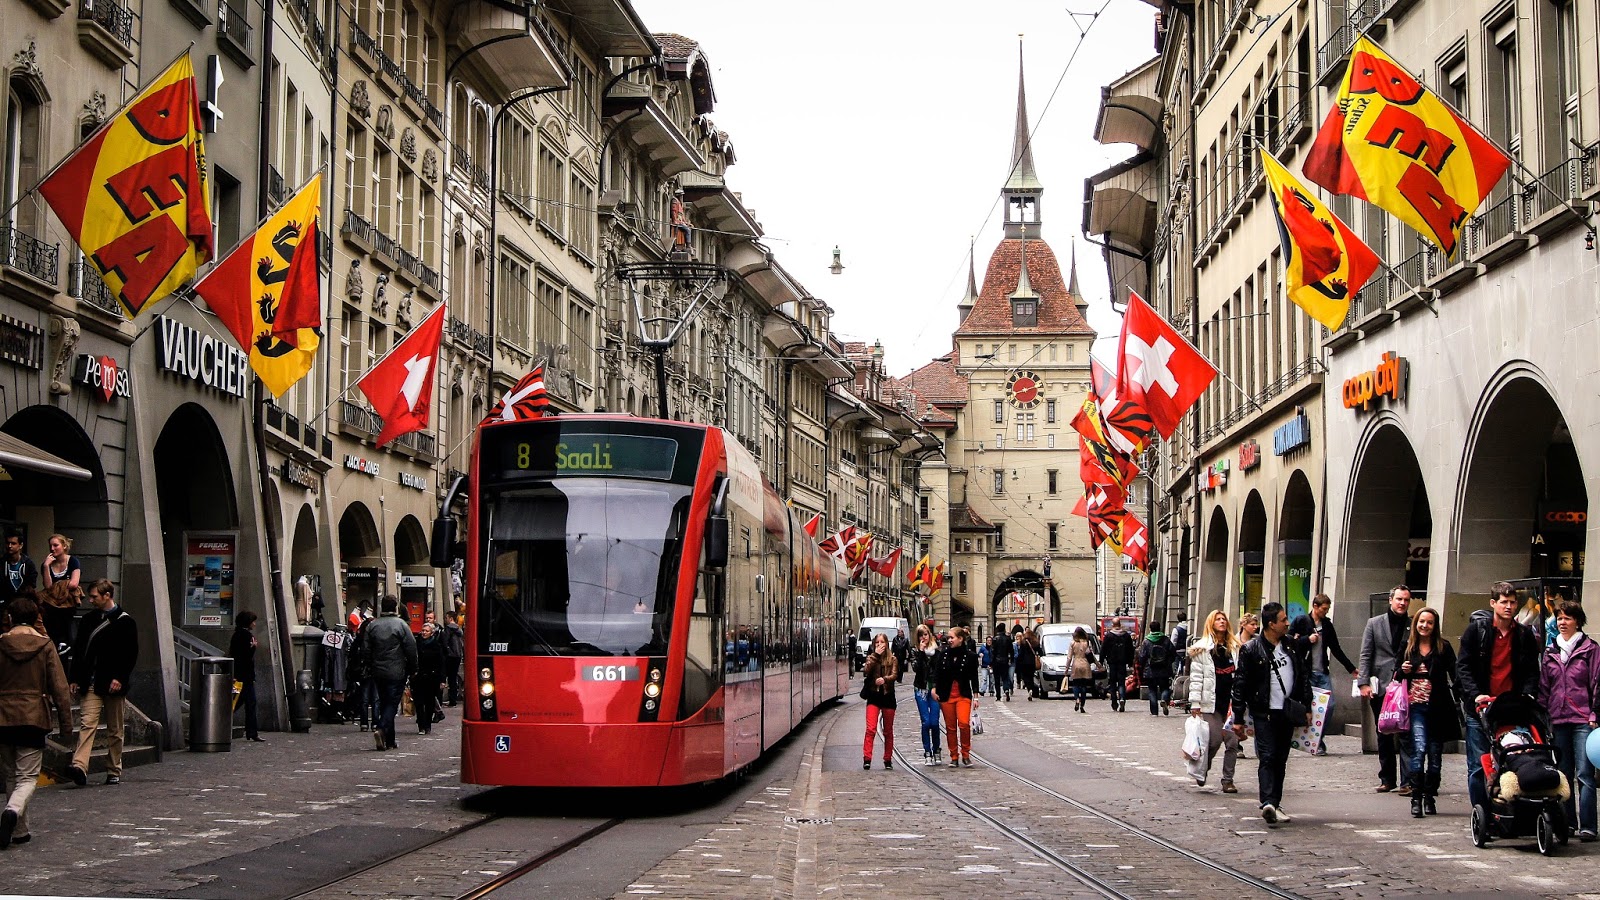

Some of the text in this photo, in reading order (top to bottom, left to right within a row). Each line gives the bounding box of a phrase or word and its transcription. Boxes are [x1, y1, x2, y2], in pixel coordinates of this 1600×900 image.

[162, 314, 248, 399] VAUCHER
[83, 355, 131, 397] Perosa
[1342, 351, 1400, 411] coop city
[346, 454, 380, 476] JACK JONES
[518, 443, 612, 469] 8 Saali
[1545, 511, 1587, 524] coop
[592, 665, 627, 681] 661
